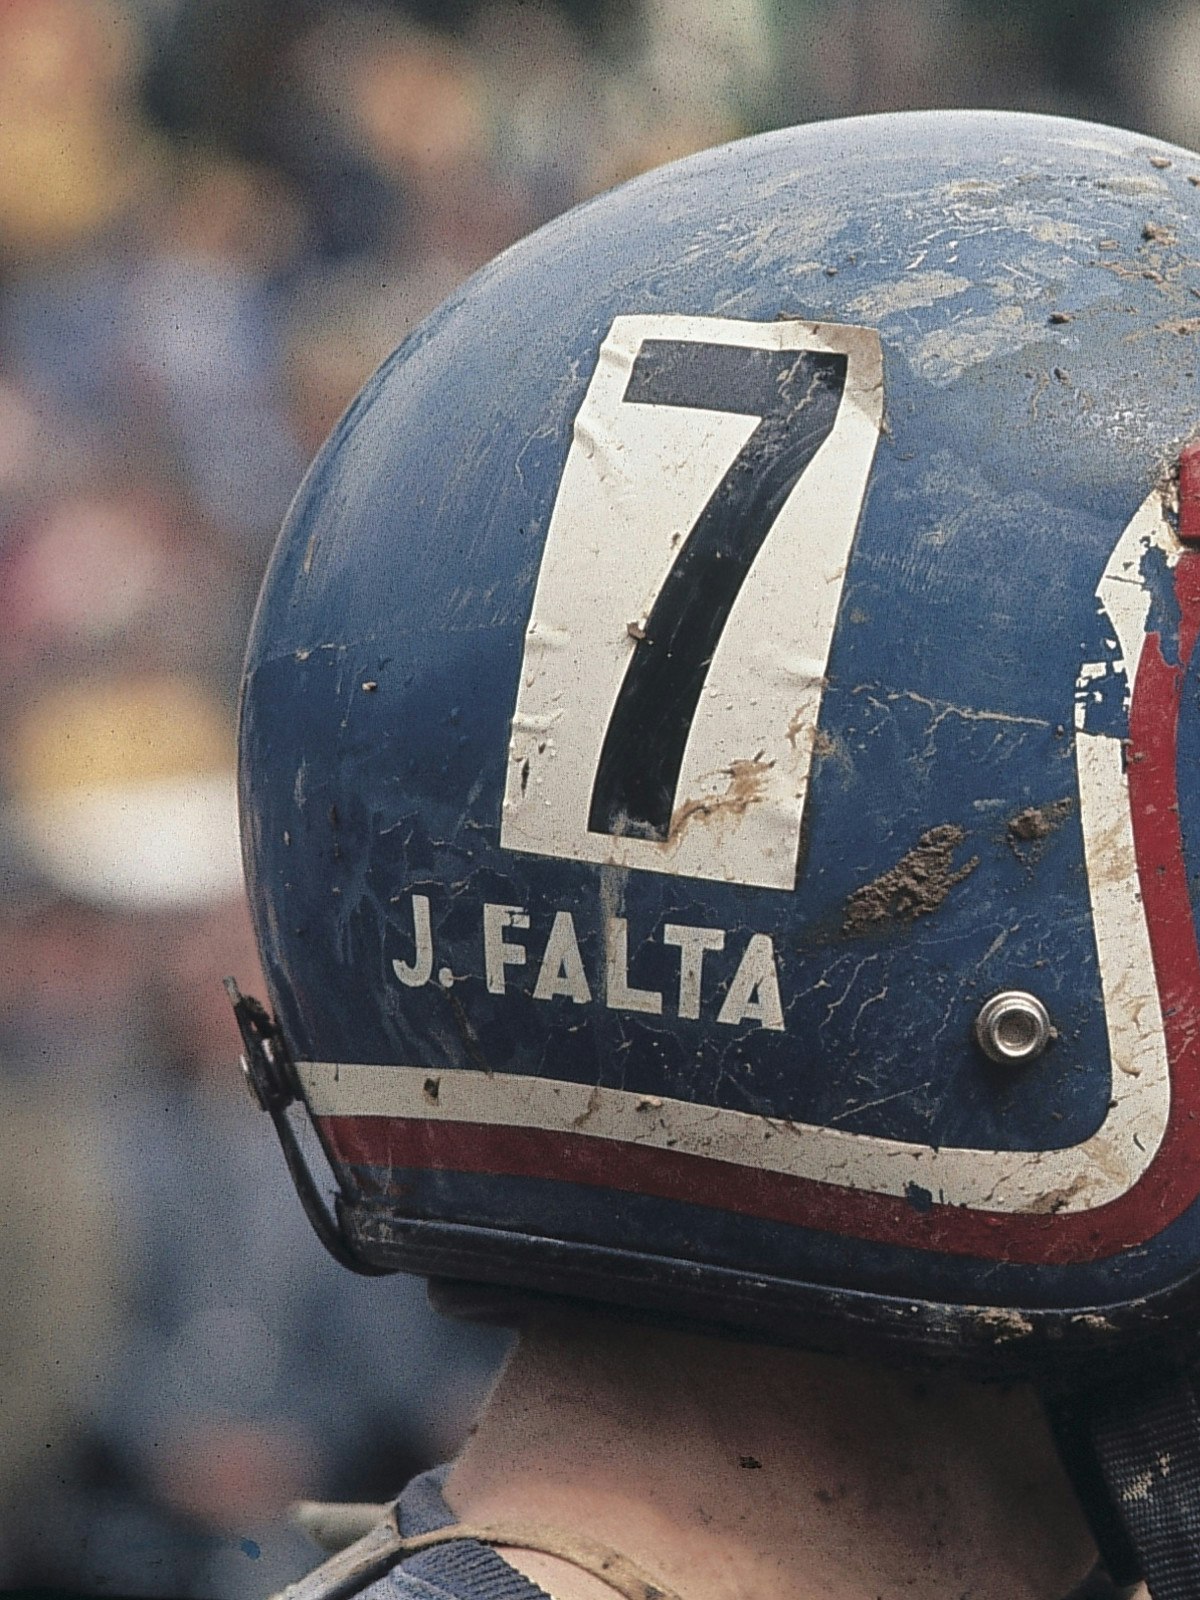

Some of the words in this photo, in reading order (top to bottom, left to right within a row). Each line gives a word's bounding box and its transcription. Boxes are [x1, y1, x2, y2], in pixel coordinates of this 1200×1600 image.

[586, 338, 848, 843] 7
[392, 894, 455, 988] J.
[483, 903, 786, 1031] FALTA
